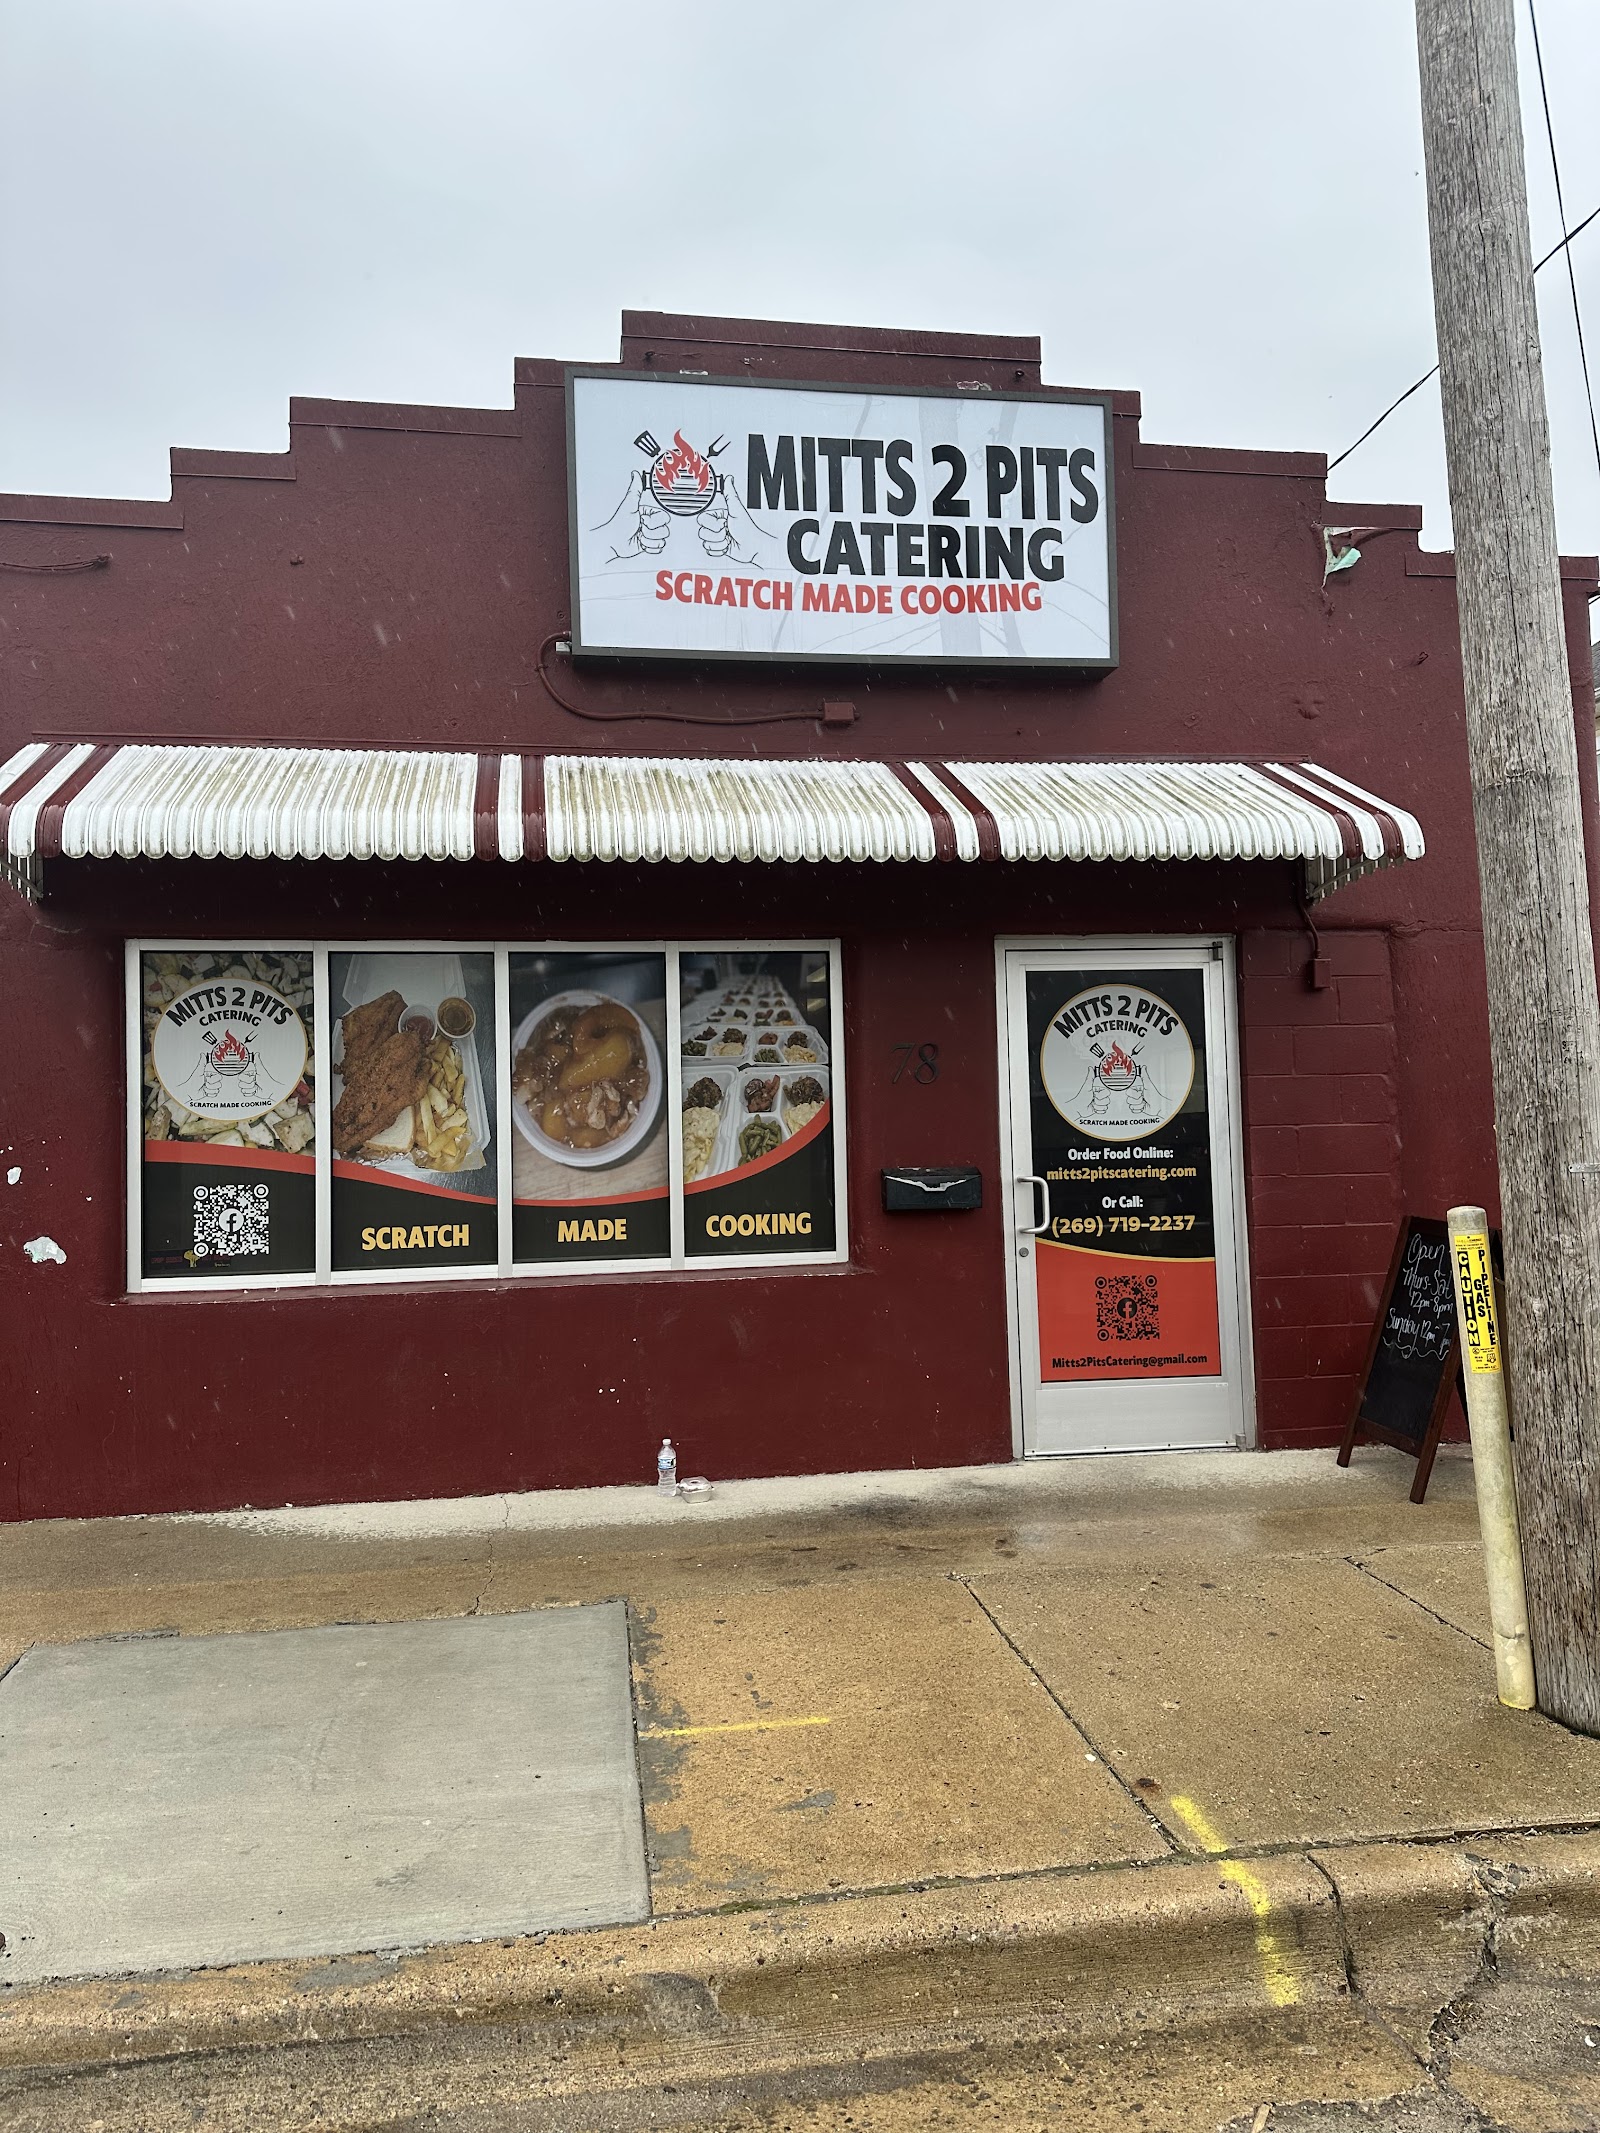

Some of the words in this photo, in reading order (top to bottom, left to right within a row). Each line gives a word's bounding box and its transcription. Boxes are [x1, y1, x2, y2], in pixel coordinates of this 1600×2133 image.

[746, 434, 917, 516] MITTS
[931, 445, 970, 518] 2
[985, 445, 1098, 524] PITS
[787, 518, 1065, 582] CATERING
[655, 570, 793, 611] SCRATCH
[801, 582, 893, 614] MADE
[899, 581, 1043, 615] COOKING
[165, 986, 227, 1027] MITTS
[231, 987, 246, 1006] 2
[249, 990, 294, 1025] PITS
[199, 1009, 262, 1027] CATERING
[1053, 994, 1113, 1039] MITTS
[1117, 995, 1132, 1017] 2
[1134, 998, 1179, 1036] PITS
[1085, 1019, 1148, 1038] CATERING
[890, 1042, 939, 1085] 78
[240, 1100, 272, 1108] COOKING
[1079, 1118, 1108, 1126] SCRATCH
[1129, 1117, 1160, 1125] COOKING
[1067, 1148, 1101, 1161] Order
[1103, 1146, 1131, 1160] Food
[1133, 1146, 1174, 1159] Online:
[1046, 1164, 1197, 1182] mitts2pitscatering.com
[1101, 1196, 1118, 1209] Or
[1118, 1195, 1144, 1208] Call:
[361, 1224, 470, 1251] SCRATCH
[557, 1218, 628, 1243] MADE
[705, 1211, 812, 1238] COOKING
[1051, 1216, 1104, 1238] (269)
[1108, 1215, 1196, 1233] 719-2237
[1407, 1233, 1445, 1276] Open
[1457, 1252, 1480, 1345] CAUTION
[1473, 1278, 1486, 1318] GAS
[1478, 1249, 1497, 1346] PIPELINE
[1386, 1307, 1420, 1350] Sunday
[1051, 1353, 1208, 1369] Mitts2PitsCatering@gmail.com
